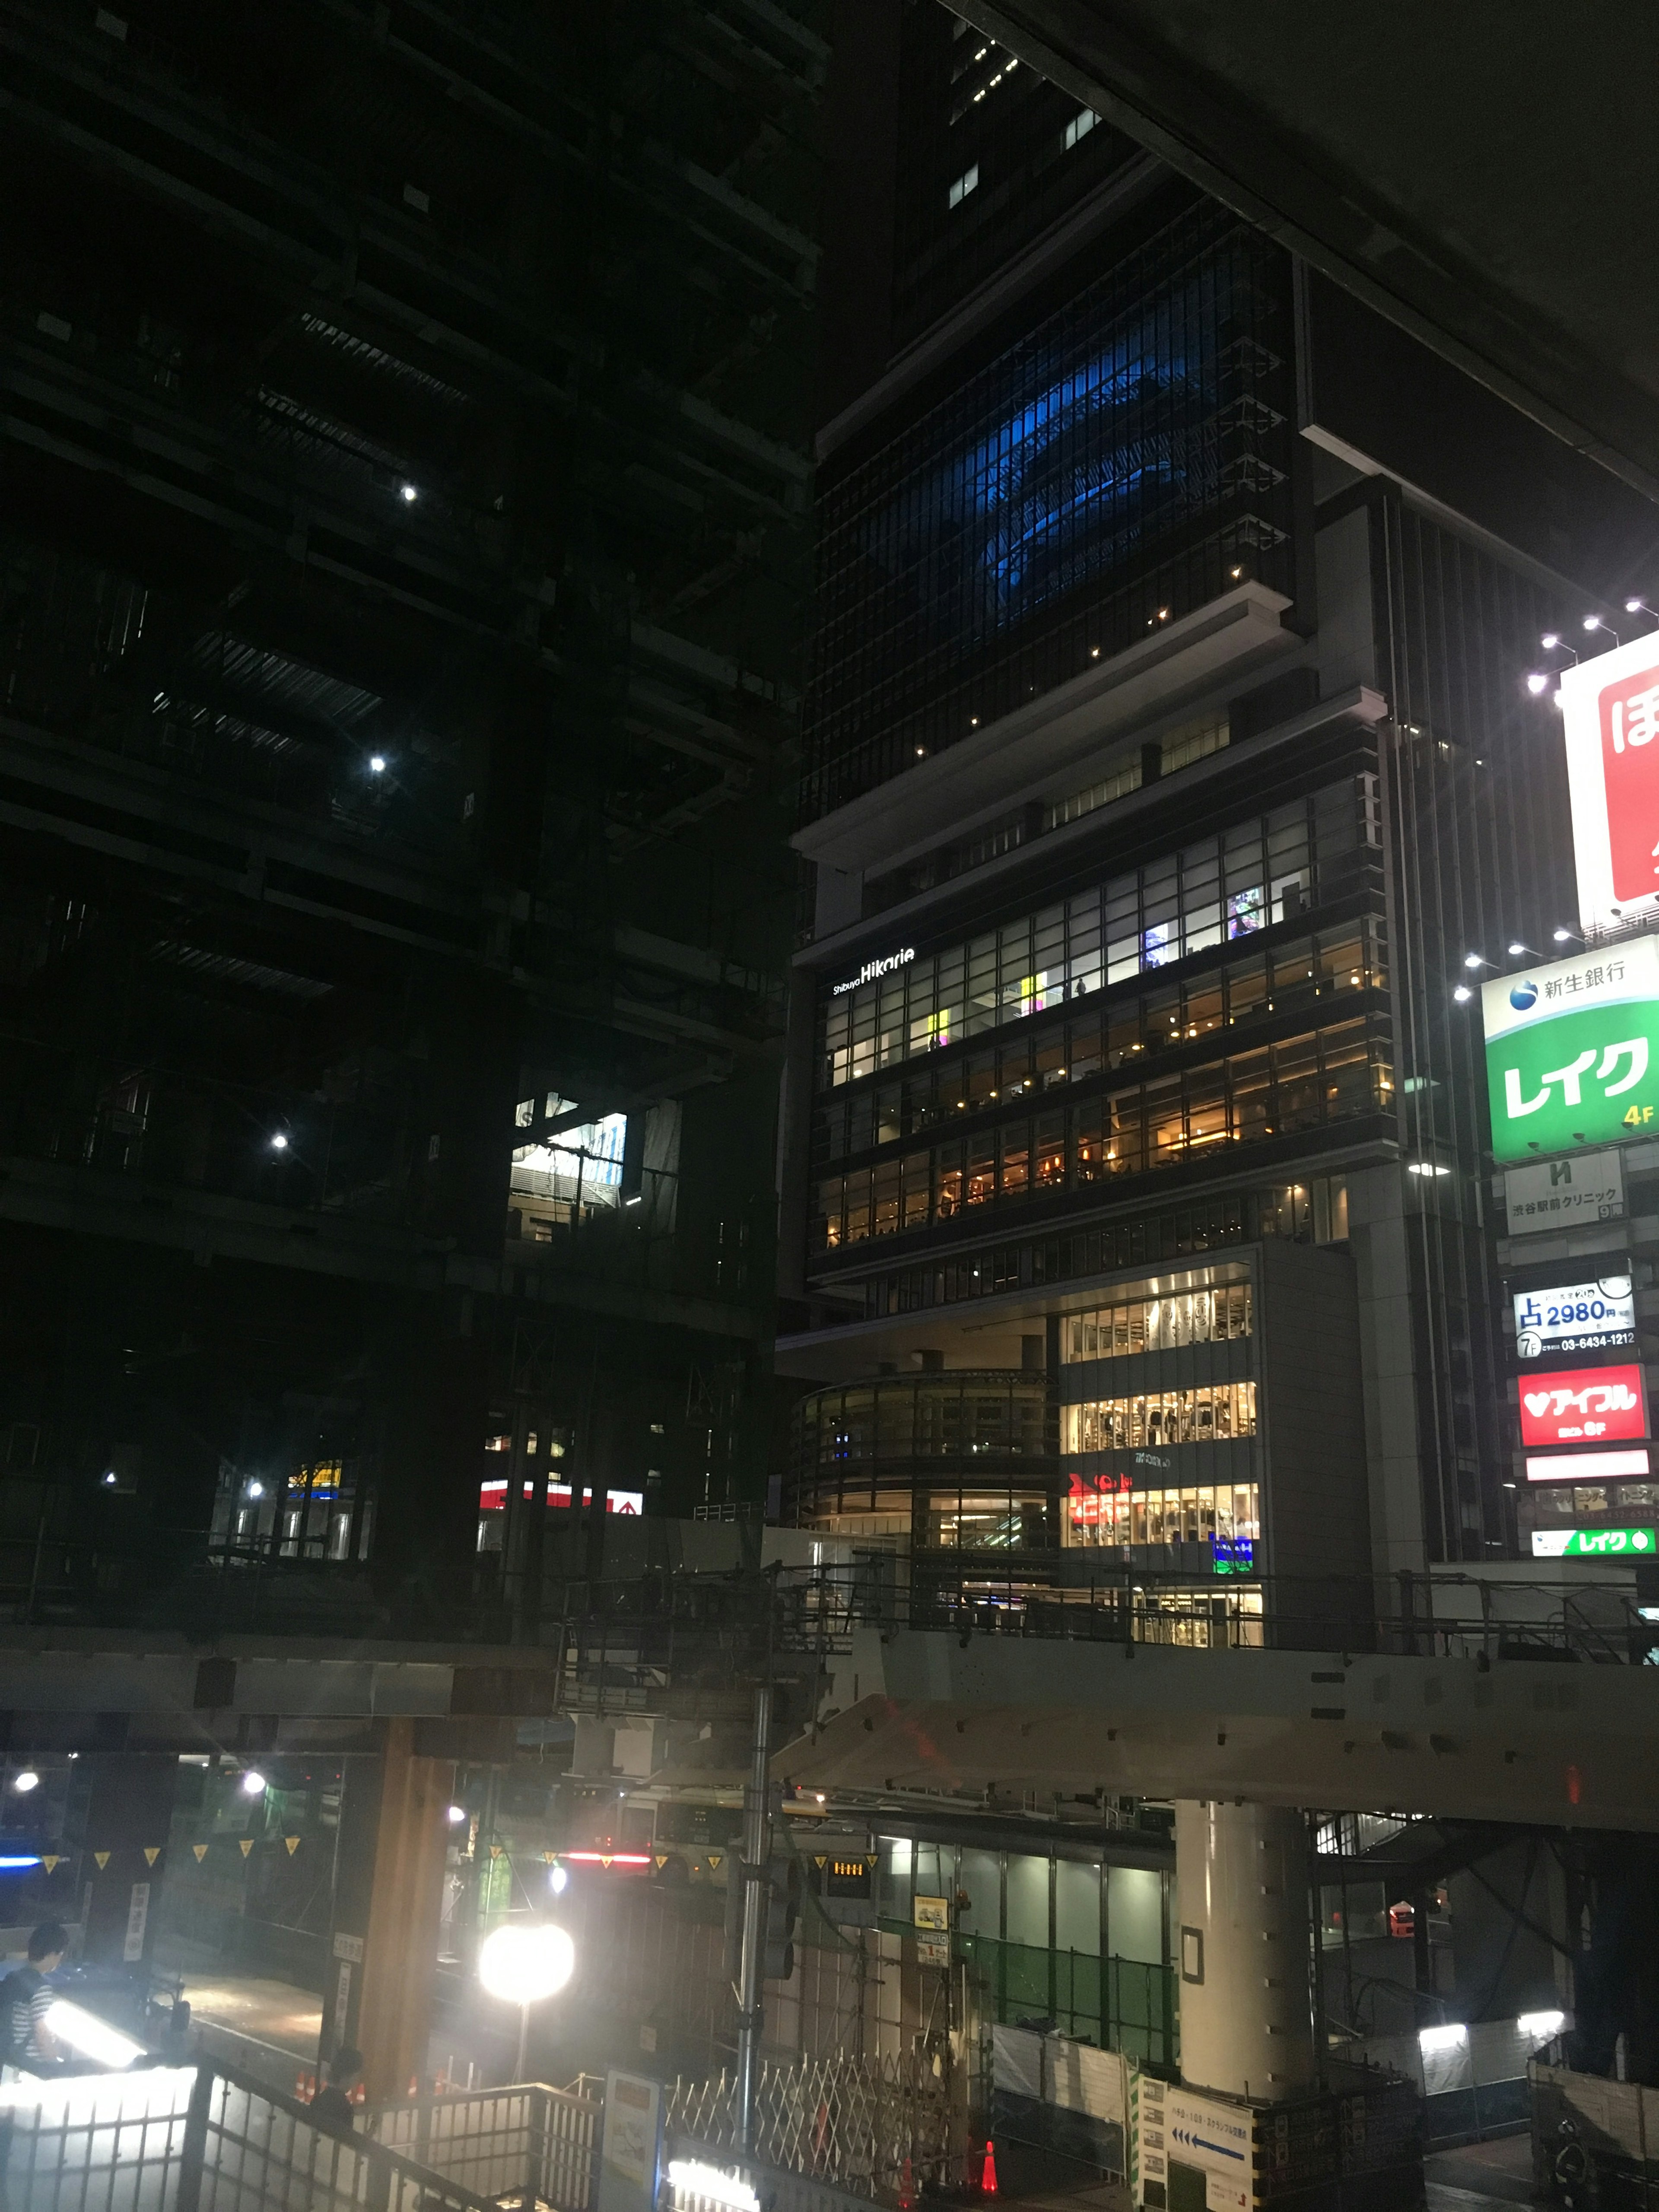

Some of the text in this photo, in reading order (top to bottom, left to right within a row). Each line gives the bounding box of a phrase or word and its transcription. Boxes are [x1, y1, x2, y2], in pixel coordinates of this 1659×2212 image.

[833, 947, 915, 995] Shibuya Hikarie
[1544, 961, 1626, 999] 新生銀行
[1504, 1037, 1649, 1119] レイク
[1624, 1105, 1654, 1125] 4F
[1513, 1188, 1616, 1217] 渋谷駅前クリニック
[1520, 1297, 1542, 1328] 占
[1521, 1338, 1537, 1356] 7F
[1562, 1333, 1635, 1351] 03-6434-1212
[1550, 1384, 1637, 1416] アイフル
[1580, 1532, 1627, 1552] レイク
